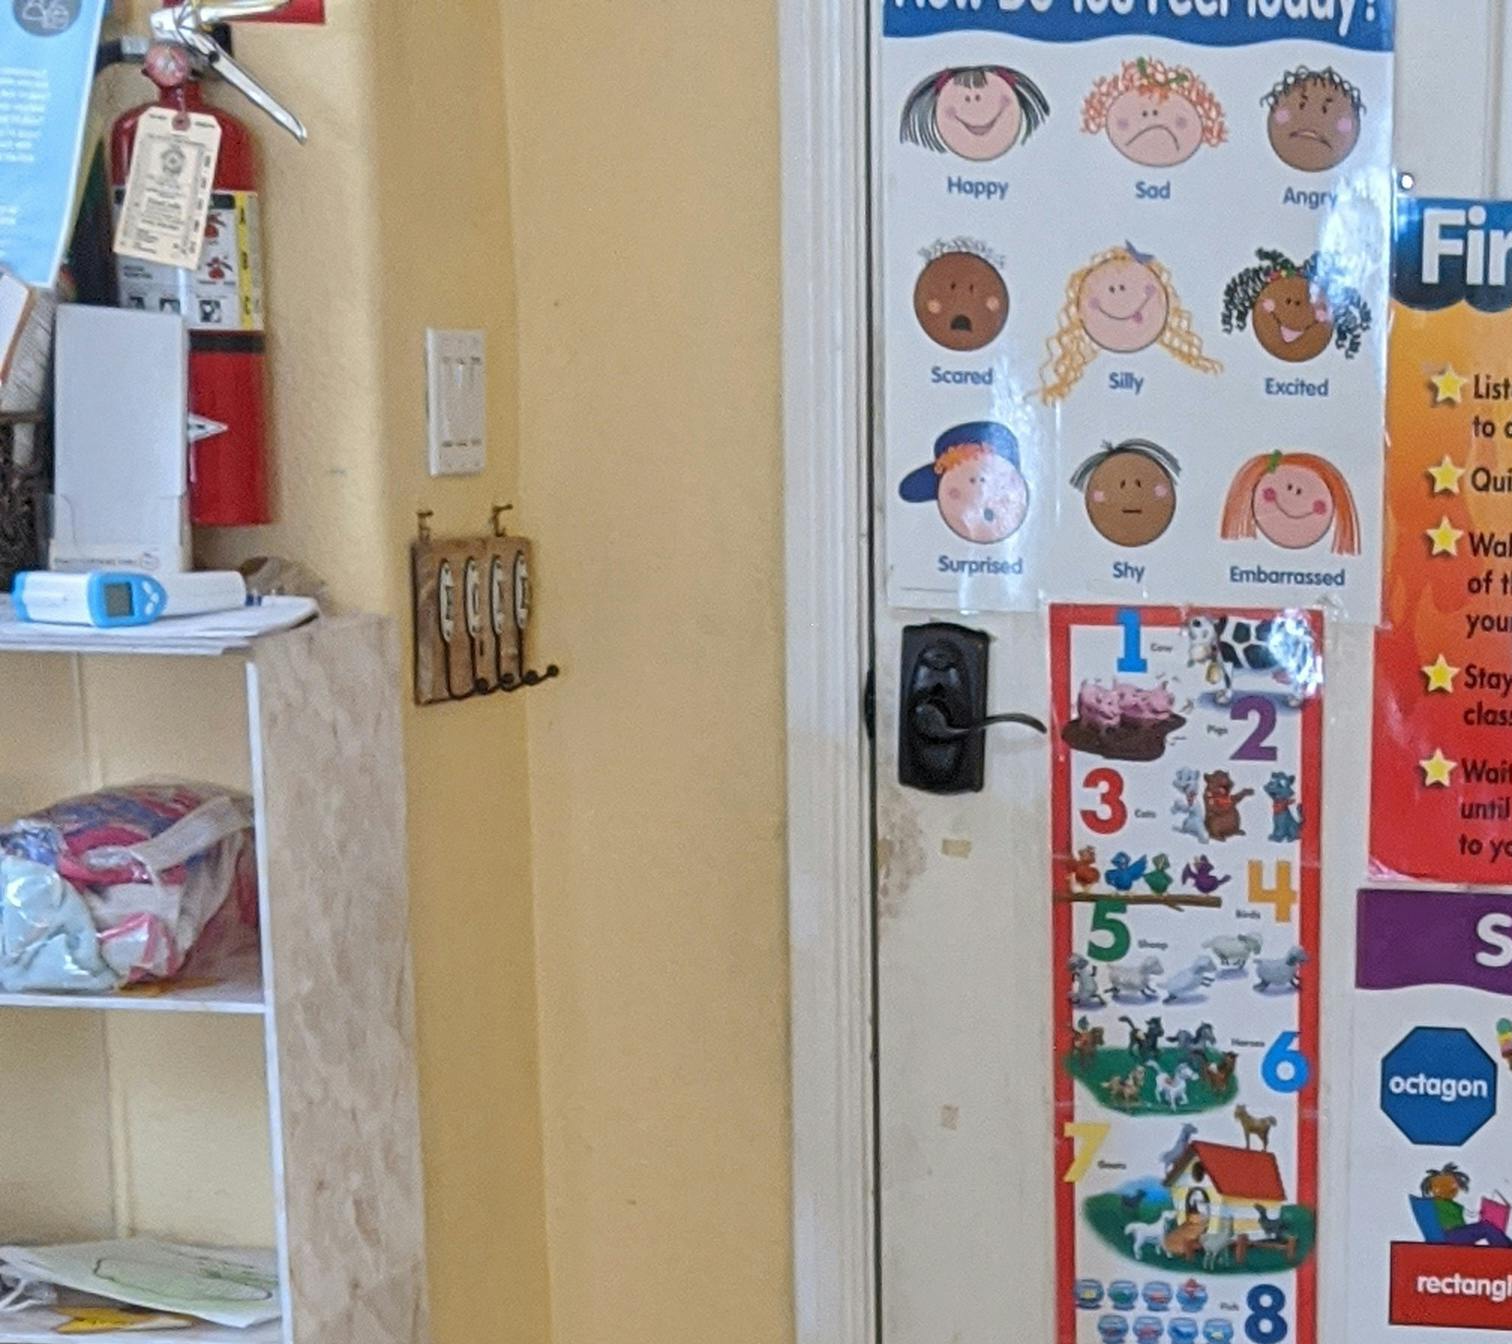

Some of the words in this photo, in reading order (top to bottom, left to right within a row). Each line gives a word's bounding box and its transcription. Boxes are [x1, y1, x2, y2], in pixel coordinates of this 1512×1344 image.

[948, 177, 1008, 199] Happy
[1135, 181, 1171, 199] Sad
[1283, 187, 1338, 208] Angry
[931, 367, 993, 386] Scared
[1109, 372, 1144, 393] Silly
[1264, 378, 1329, 397] Excited
[1472, 415, 1496, 438] to
[938, 556, 1022, 577] Surprised
[1112, 561, 1145, 583] Shy
[1229, 566, 1345, 587] Embarrassed
[1468, 570, 1494, 595] of
[1116, 610, 1148, 673] 1
[1229, 696, 1278, 761] 2
[1080, 768, 1127, 834] 3
[1460, 797, 1510, 820] until
[1459, 834, 1482, 856] to
[1248, 860, 1297, 923] 4
[1087, 902, 1131, 962] 5
[1260, 1031, 1311, 1093] 6
[1389, 1075, 1488, 1101] octagon
[1063, 1122, 1113, 1183] 7
